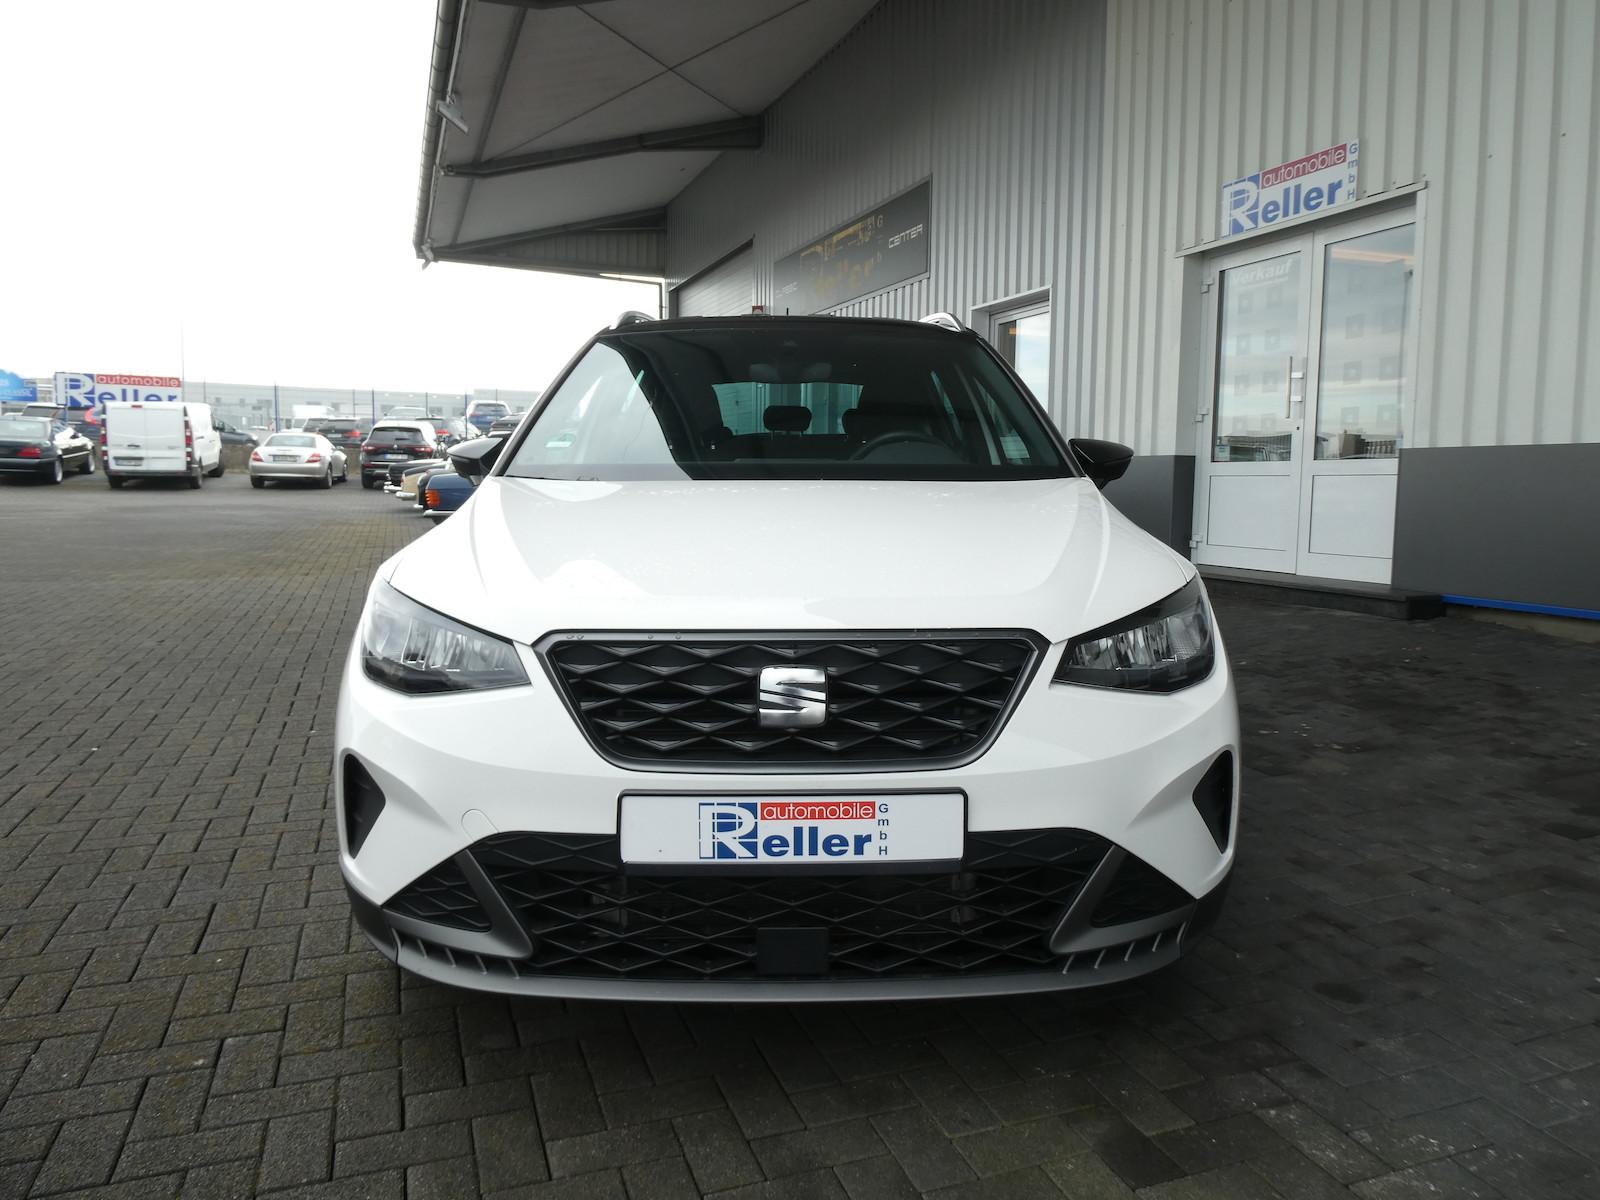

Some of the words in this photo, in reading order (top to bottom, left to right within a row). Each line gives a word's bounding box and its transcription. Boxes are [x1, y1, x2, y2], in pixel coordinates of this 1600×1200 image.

[1263, 149, 1345, 187] automobile
[1221, 178, 1344, 237] Reller
[889, 224, 923, 249] CENTER
[1231, 258, 1293, 284] Verkauf
[97, 375, 180, 387] automobile
[763, 803, 873, 819] automobile
[699, 804, 872, 859] Reller
[878, 803, 889, 856] GmbH
